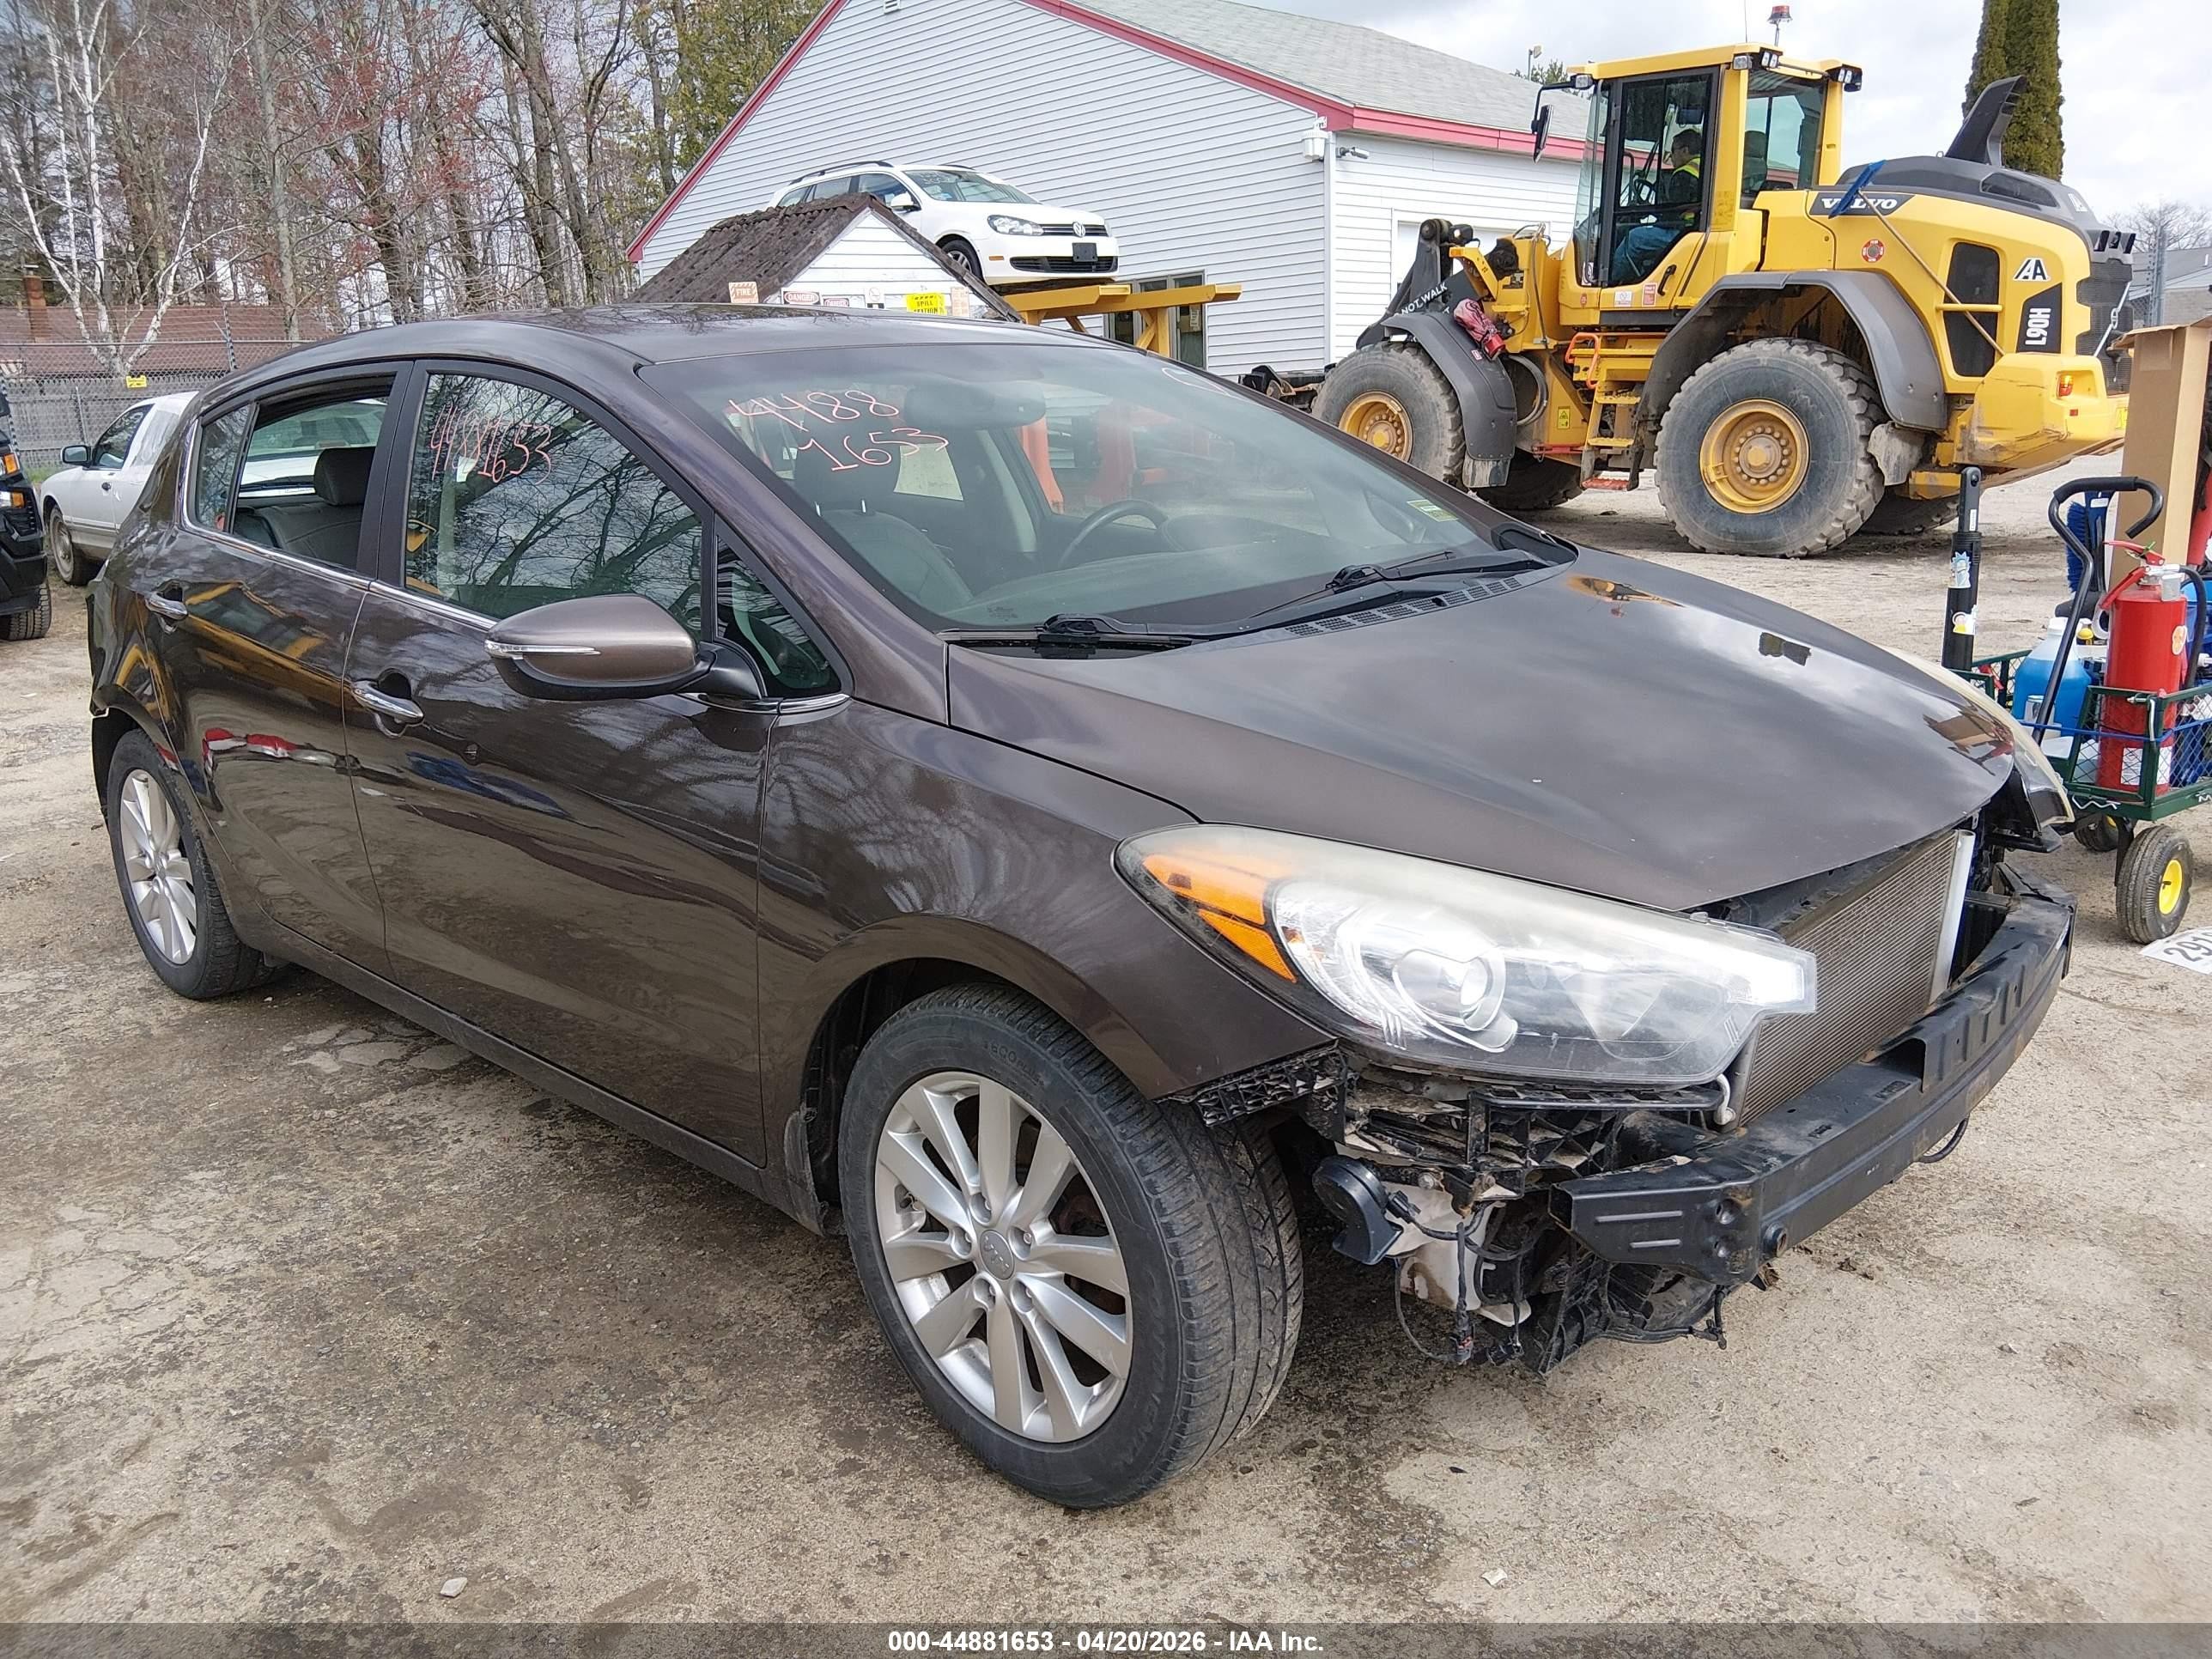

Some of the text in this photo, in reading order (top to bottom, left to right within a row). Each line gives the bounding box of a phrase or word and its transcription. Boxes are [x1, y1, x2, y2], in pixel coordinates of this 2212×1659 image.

[1821, 198, 1898, 210] VLVO
[787, 293, 815, 301] DANGER
[1420, 282, 1448, 304] WALK
[2025, 307, 2051, 346] L90H
[728, 389, 900, 432] 4488
[798, 428, 950, 471] 1653
